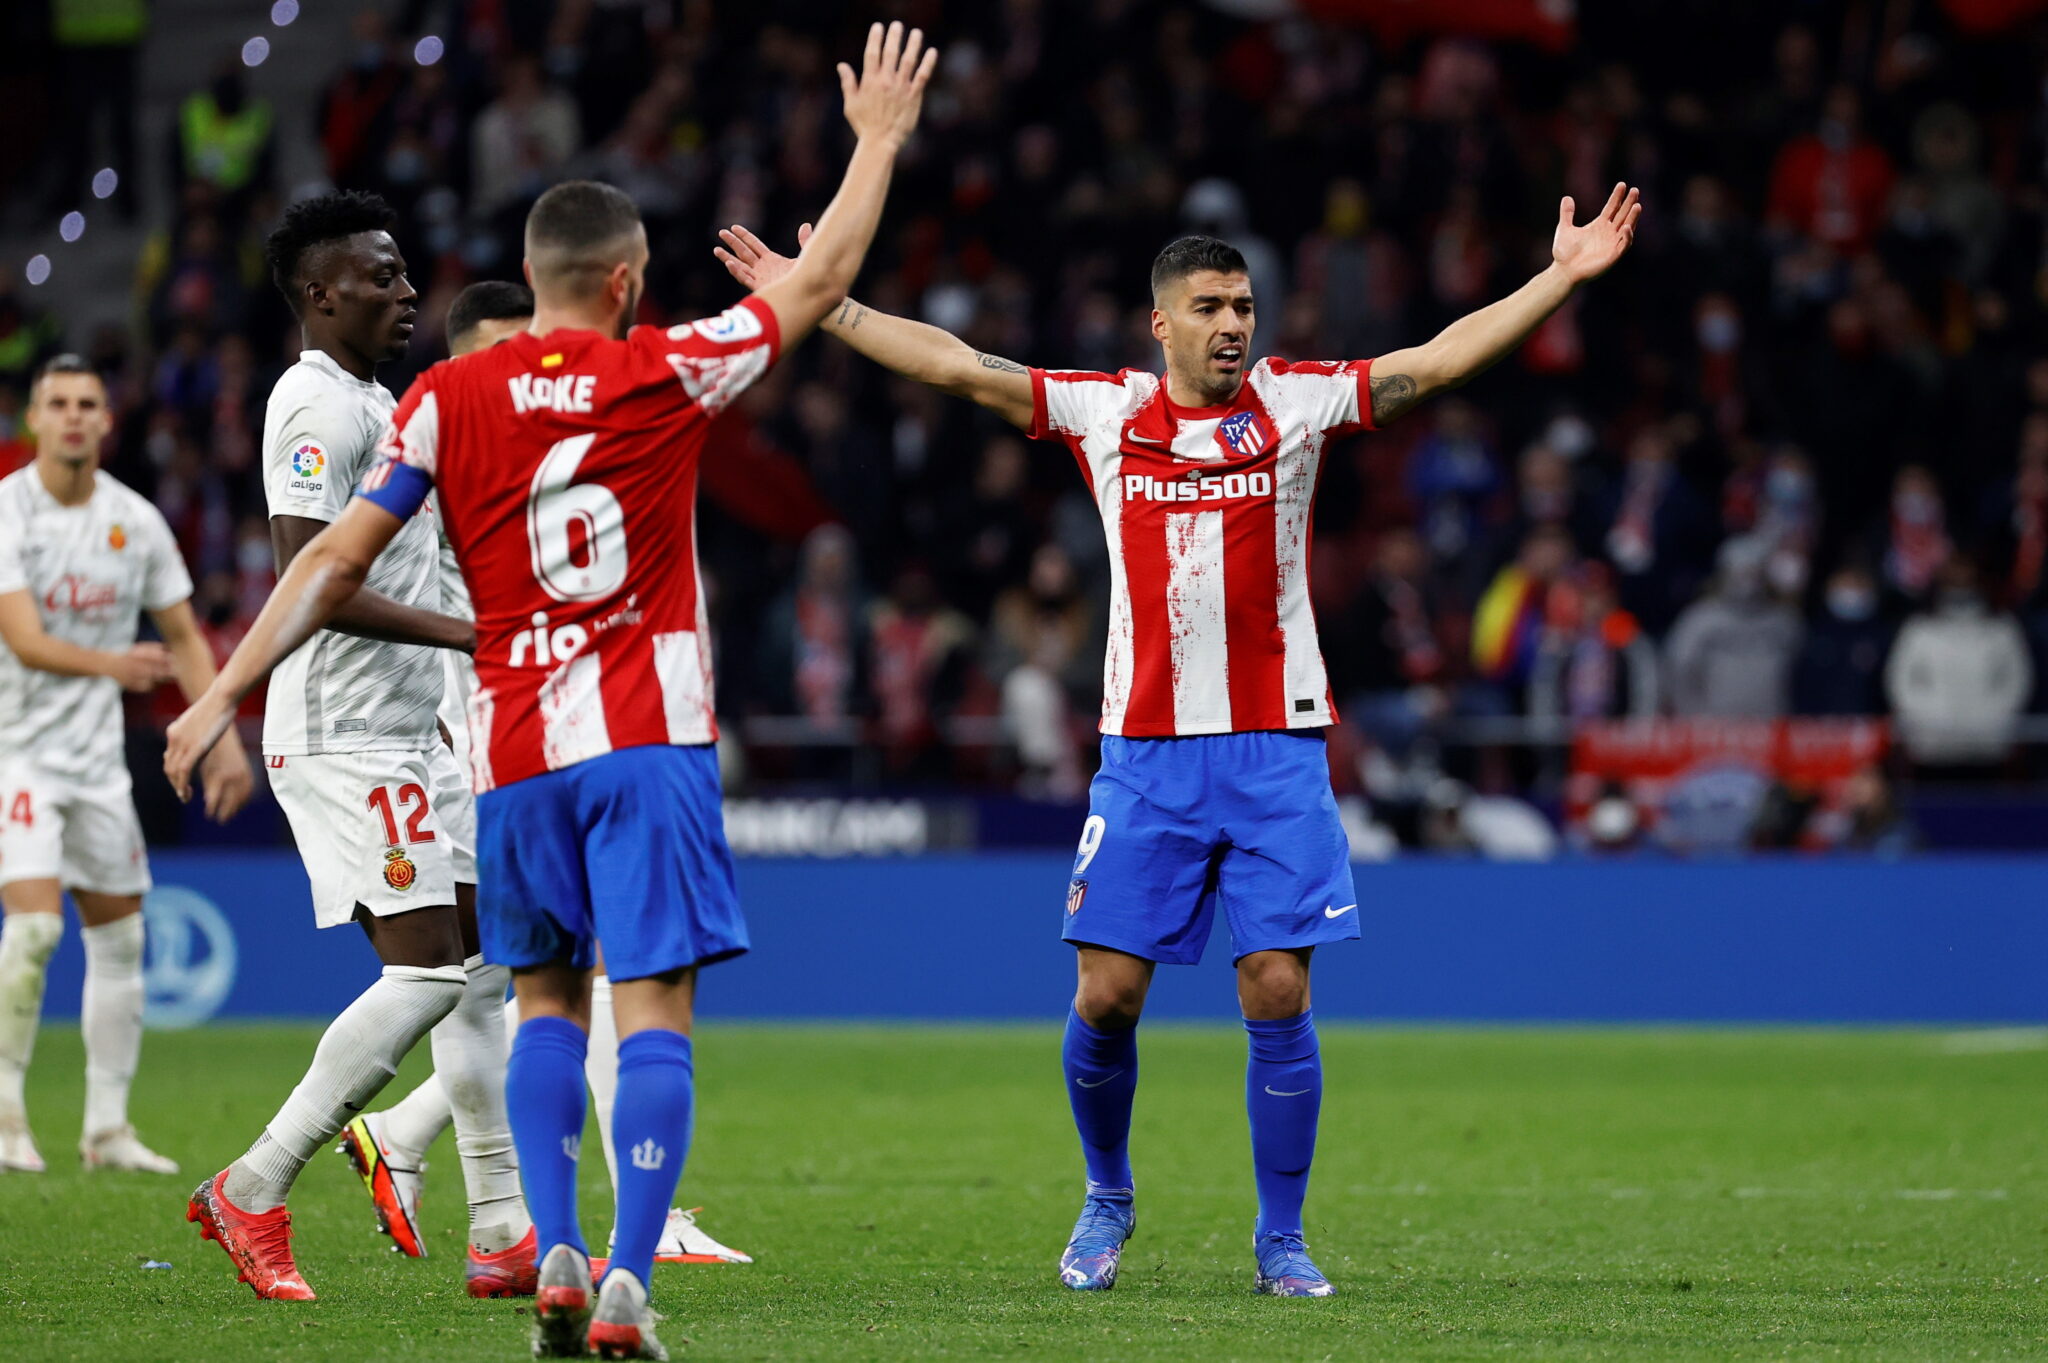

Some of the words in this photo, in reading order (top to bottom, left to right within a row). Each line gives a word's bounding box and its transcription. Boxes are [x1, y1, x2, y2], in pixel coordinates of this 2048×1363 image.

[507, 372, 597, 414] KOKE
[291, 480, 323, 491] LaLiga
[1125, 472, 1271, 502] Plus500
[527, 432, 628, 603] 6
[0, 791, 34, 828] 4
[366, 783, 436, 847] 12
[1074, 814, 1106, 874] 9
